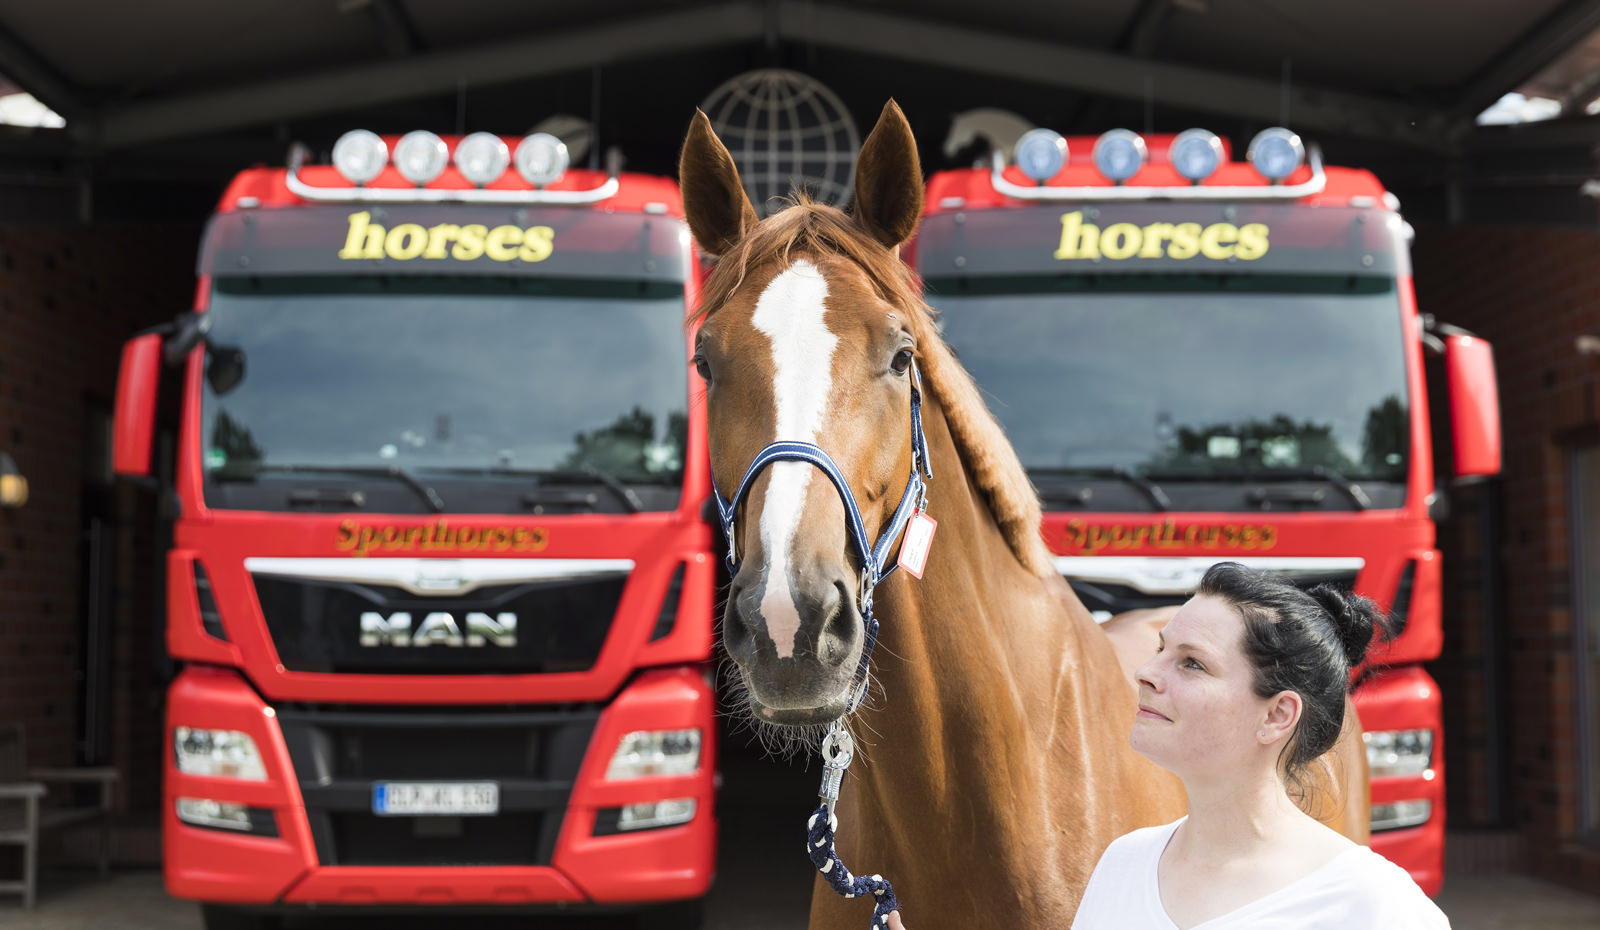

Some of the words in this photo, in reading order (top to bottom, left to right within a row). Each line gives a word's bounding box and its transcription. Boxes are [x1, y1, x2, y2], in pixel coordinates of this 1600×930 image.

[338, 210, 555, 262] horses
[1054, 210, 1270, 260] horses
[335, 518, 549, 557] Sporthorses
[360, 611, 517, 647] MAN
